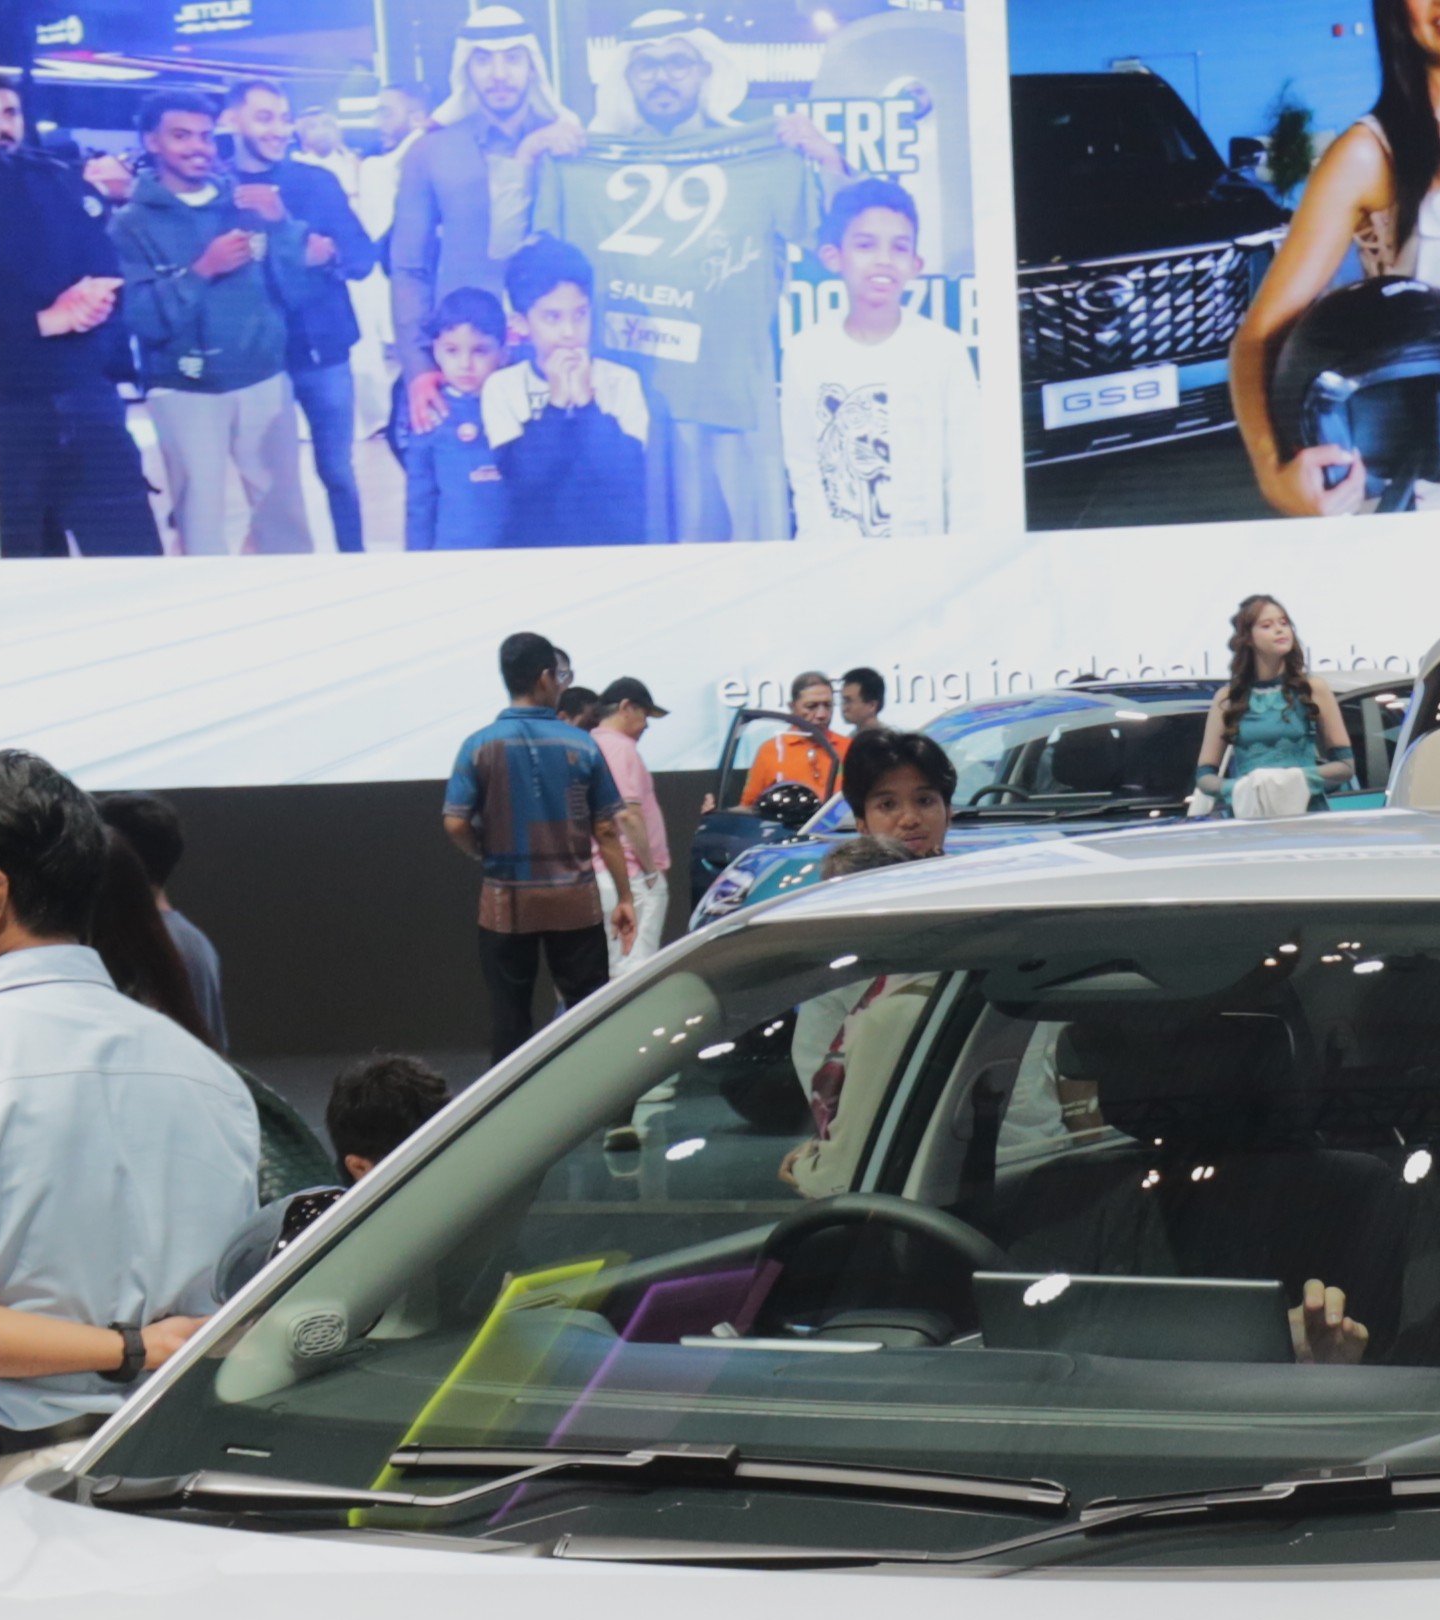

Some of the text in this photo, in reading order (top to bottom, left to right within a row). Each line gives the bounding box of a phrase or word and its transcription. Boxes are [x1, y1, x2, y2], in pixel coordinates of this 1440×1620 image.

[774, 102, 917, 173] ERE
[597, 163, 727, 257] 29
[609, 279, 694, 309] SALEM
[1062, 380, 1161, 412] GS8
